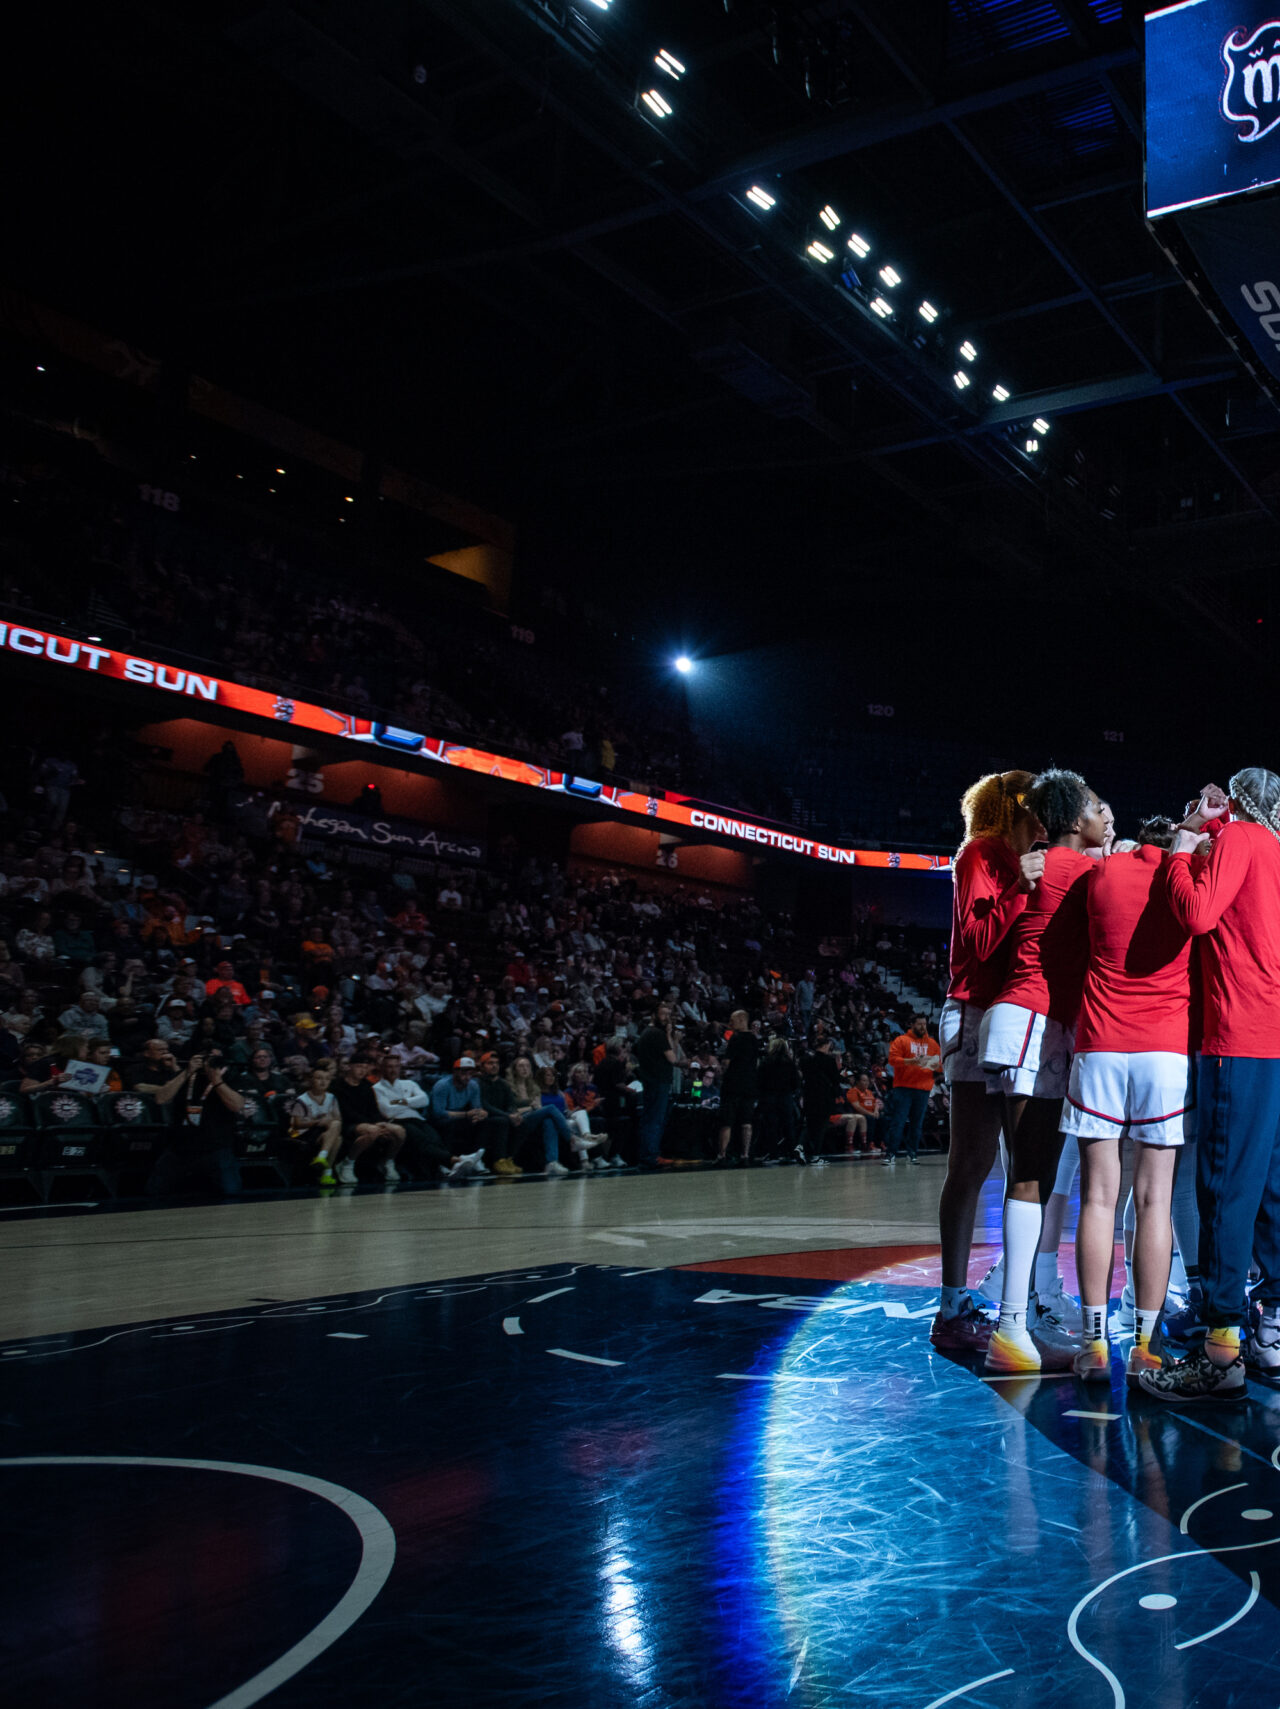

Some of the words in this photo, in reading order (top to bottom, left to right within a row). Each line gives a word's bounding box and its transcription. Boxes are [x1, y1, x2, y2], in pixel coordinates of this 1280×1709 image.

[137, 483, 180, 511] 118
[123, 658, 219, 701] SUN
[866, 703, 895, 717] 120
[1103, 729, 1125, 742] 121
[285, 768, 324, 793] 25
[371, 822, 415, 845] Sun
[418, 831, 482, 858] Arena
[690, 810, 814, 855] CONNECTICUT
[817, 845, 856, 864] SUN
[656, 849, 678, 869] 26
